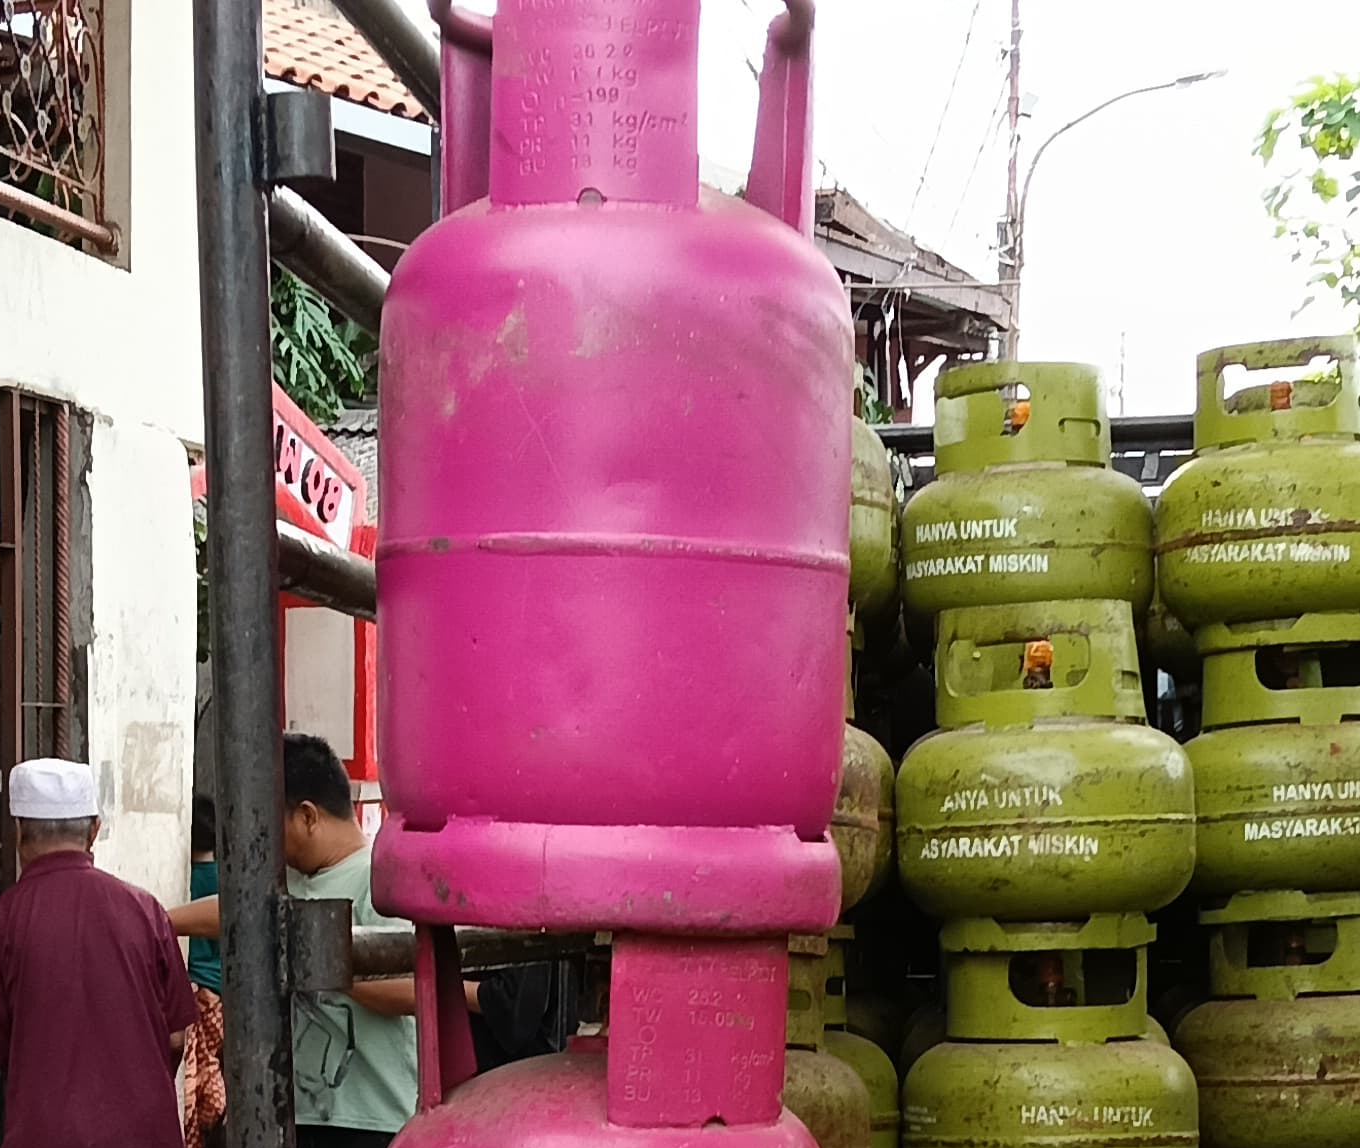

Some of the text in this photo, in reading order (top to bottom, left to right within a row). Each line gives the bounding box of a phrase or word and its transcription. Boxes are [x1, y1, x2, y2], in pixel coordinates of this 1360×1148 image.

[916, 518, 1017, 544] HANYA UNTUK
[989, 553, 1050, 574] MISKIN
[941, 784, 1064, 813] ANYA UNTUK
[1273, 783, 1334, 803] HANYA
[920, 834, 1023, 861] ASYARAKAT
